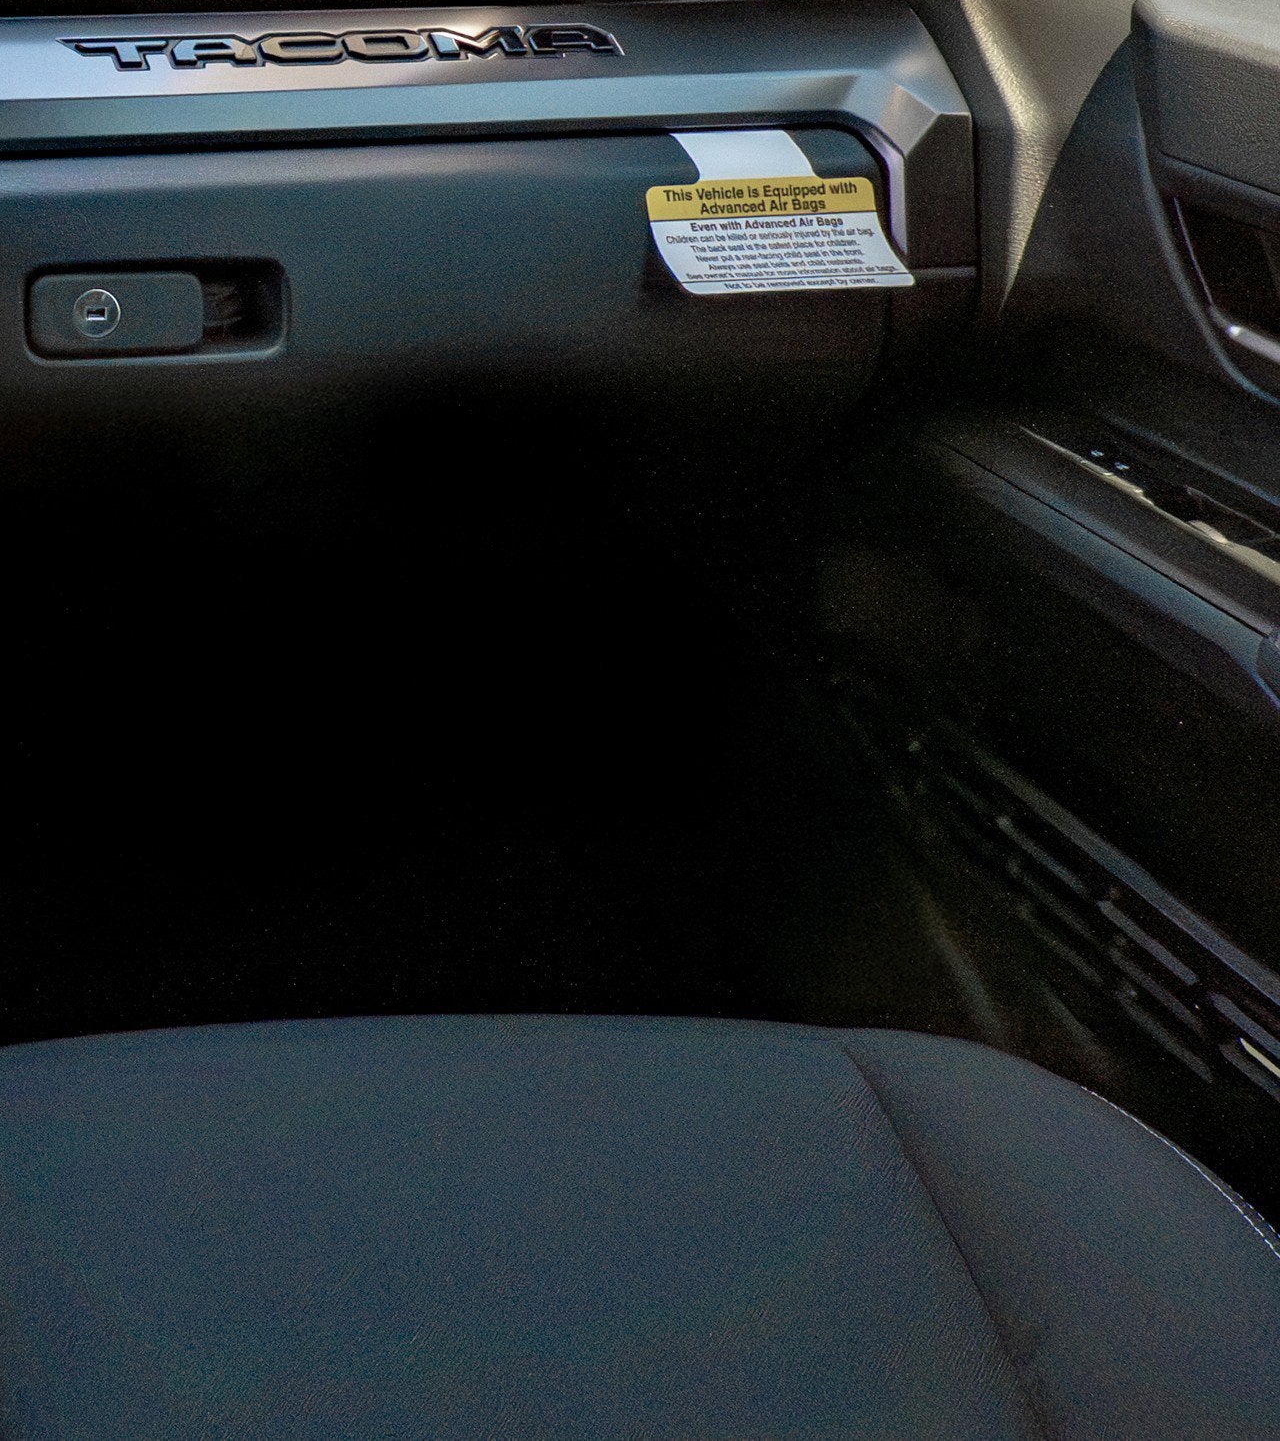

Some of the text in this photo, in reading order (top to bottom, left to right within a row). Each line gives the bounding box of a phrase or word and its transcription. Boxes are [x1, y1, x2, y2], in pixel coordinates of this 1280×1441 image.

[56, 23, 625, 71] TACOMA
[663, 189, 693, 202] This
[696, 187, 744, 201] Vehicle
[763, 183, 826, 200] Equipped
[829, 182, 857, 195] with
[700, 199, 827, 215] Advanced Air Bags
[690, 217, 844, 232] Even with Advanced Air Bags
[666, 235, 699, 244] Children
[700, 235, 715, 243] can
[715, 234, 726, 242] be
[726, 233, 748, 241] killed
[758, 231, 793, 240] seriously
[793, 230, 820, 240] injured
[821, 229, 831, 238] by
[845, 228, 856, 236] air
